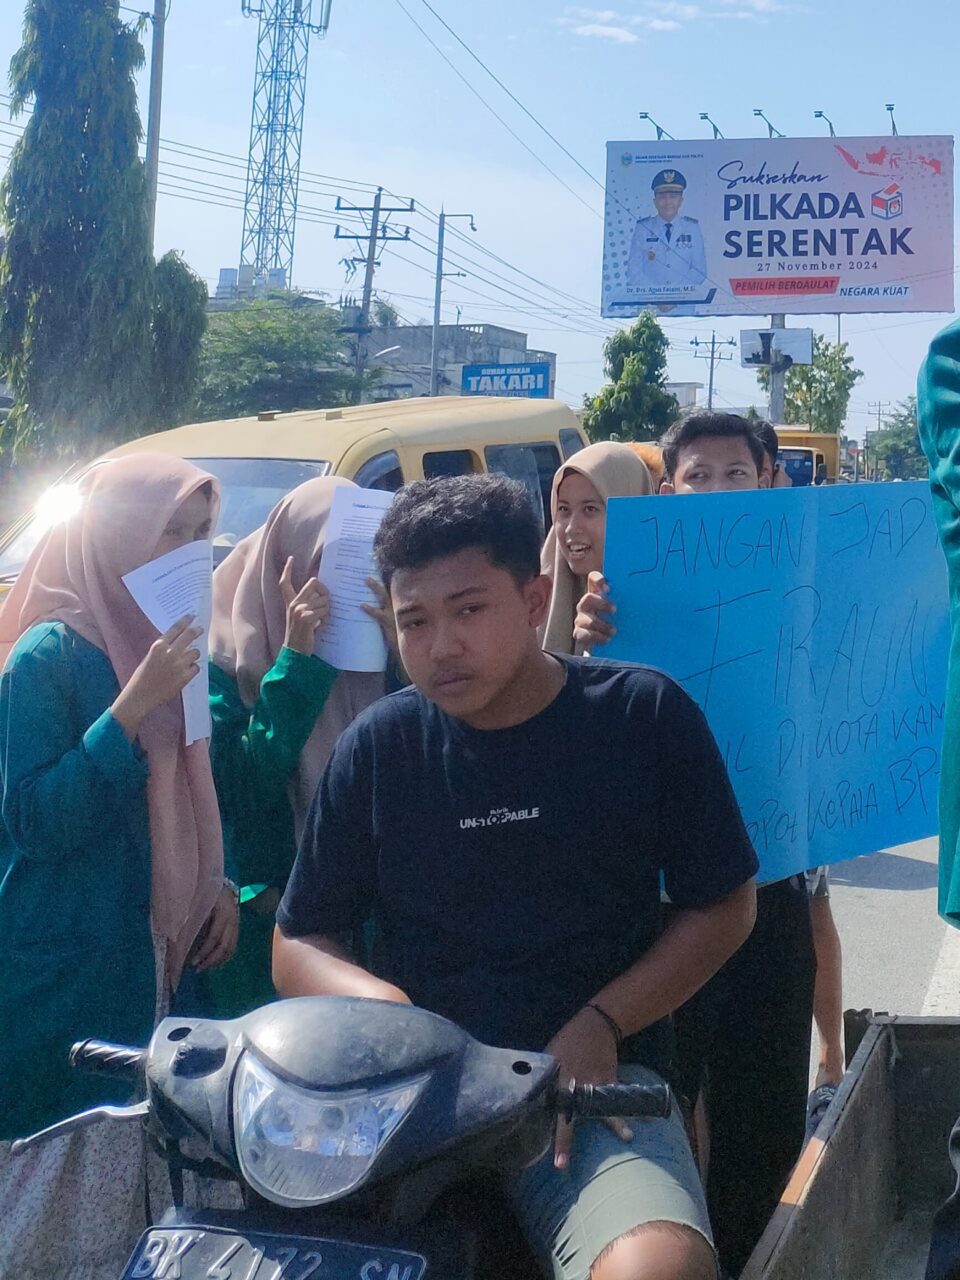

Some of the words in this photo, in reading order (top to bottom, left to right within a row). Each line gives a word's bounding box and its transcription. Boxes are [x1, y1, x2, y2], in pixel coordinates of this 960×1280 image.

[717, 160, 829, 189] Sukseskan
[723, 192, 865, 221] PILKADA
[723, 227, 915, 258] SERENTAK
[757, 263, 771, 272] 27
[777, 261, 842, 271] November
[849, 261, 878, 270] 2024
[735, 281, 776, 291] PEMILIH
[778, 280, 836, 290] BERDAULAT
[839, 287, 880, 297] NEGARA
[882, 286, 910, 296] KUAT
[467, 374, 544, 391] TAKARI
[629, 513, 805, 577] JANGAN
[830, 498, 939, 558] JAD
[679, 585, 932, 713] FIRAUN
[892, 702, 946, 742] KAM
[888, 746, 941, 816] BP
[131, 1232, 206, 1279] BK
